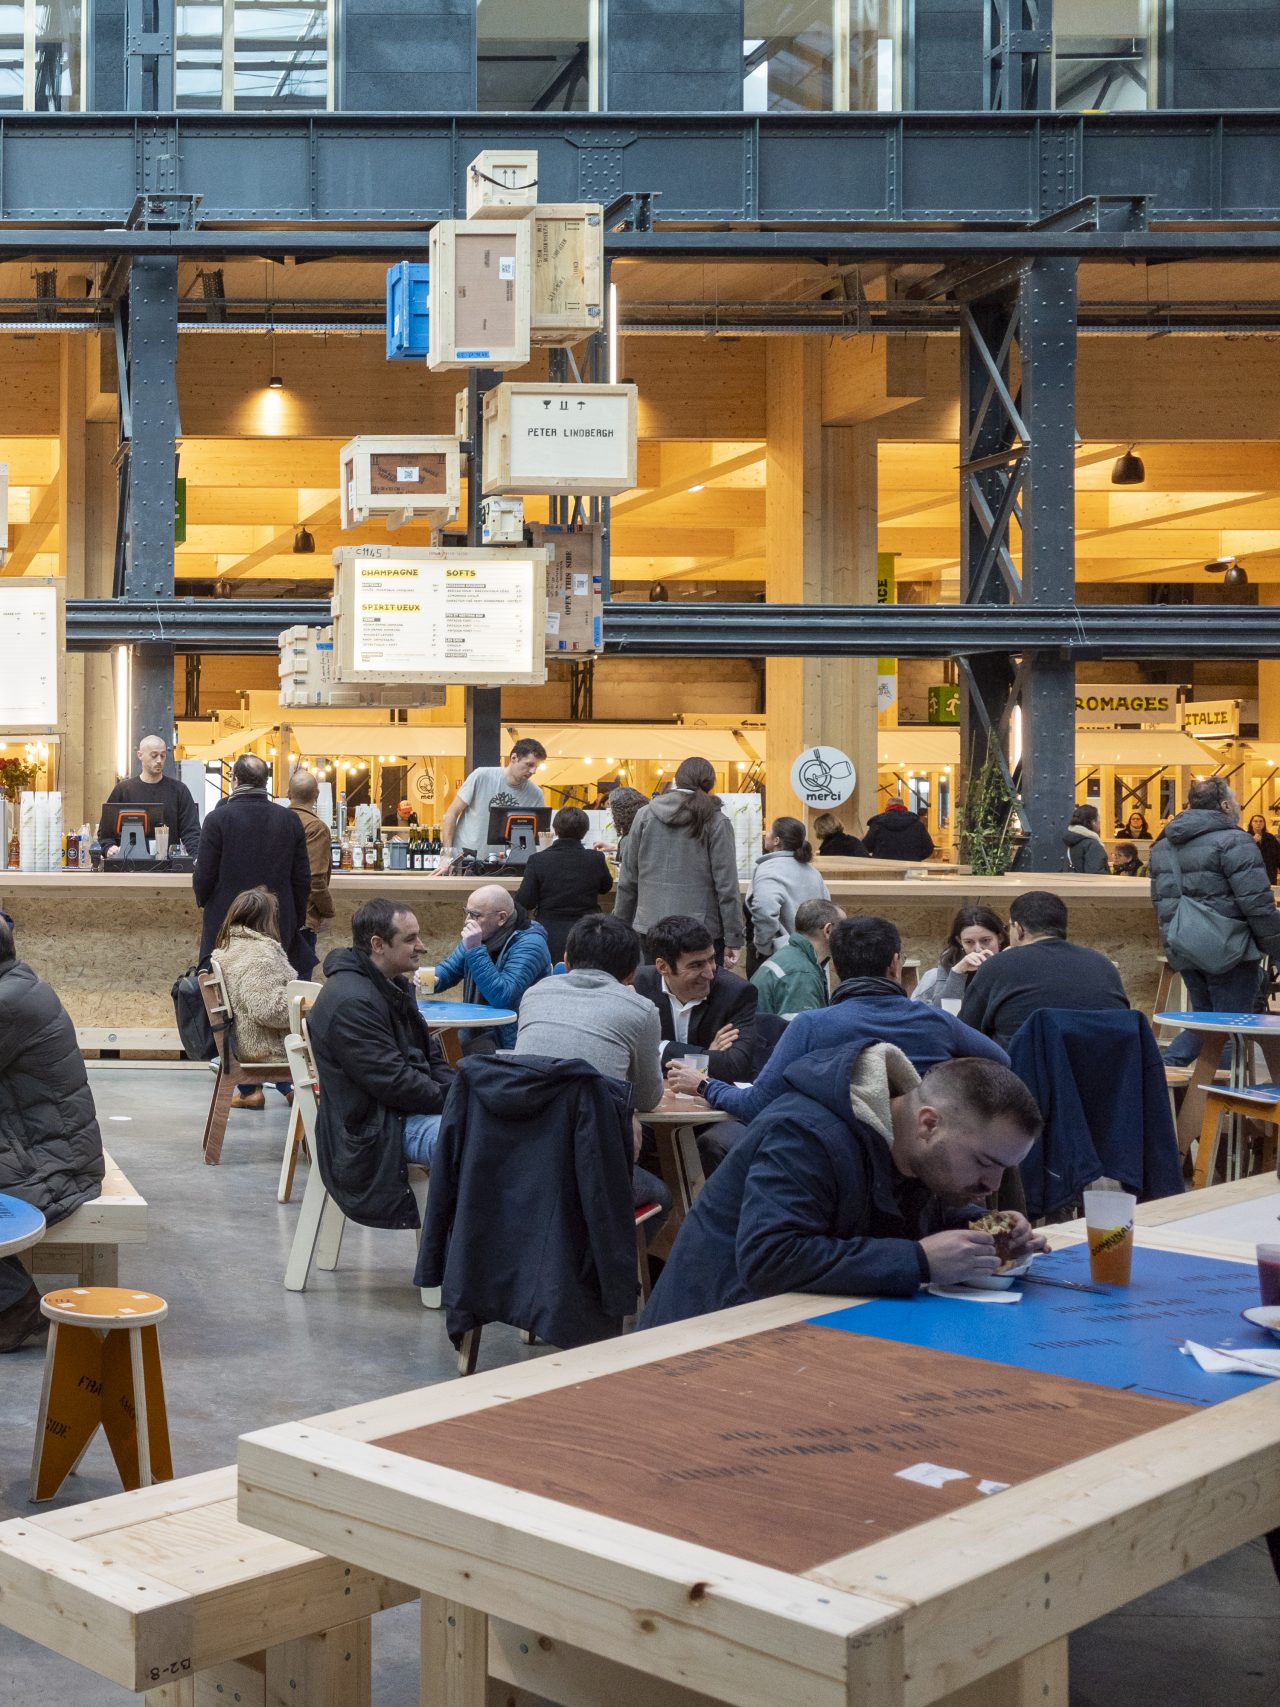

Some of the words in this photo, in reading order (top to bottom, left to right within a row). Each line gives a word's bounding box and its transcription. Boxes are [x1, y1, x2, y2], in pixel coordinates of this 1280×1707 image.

[527, 427, 557, 437] PETER
[563, 428, 614, 438] LINDBERGH
[446, 569, 476, 577] SOFTS
[878, 578, 888, 604] ACE
[1075, 696, 1169, 712] ROMAGES
[1185, 711, 1228, 726] ITALIE
[806, 792, 841, 801] merci
[77, 1375, 102, 1396] FRA
